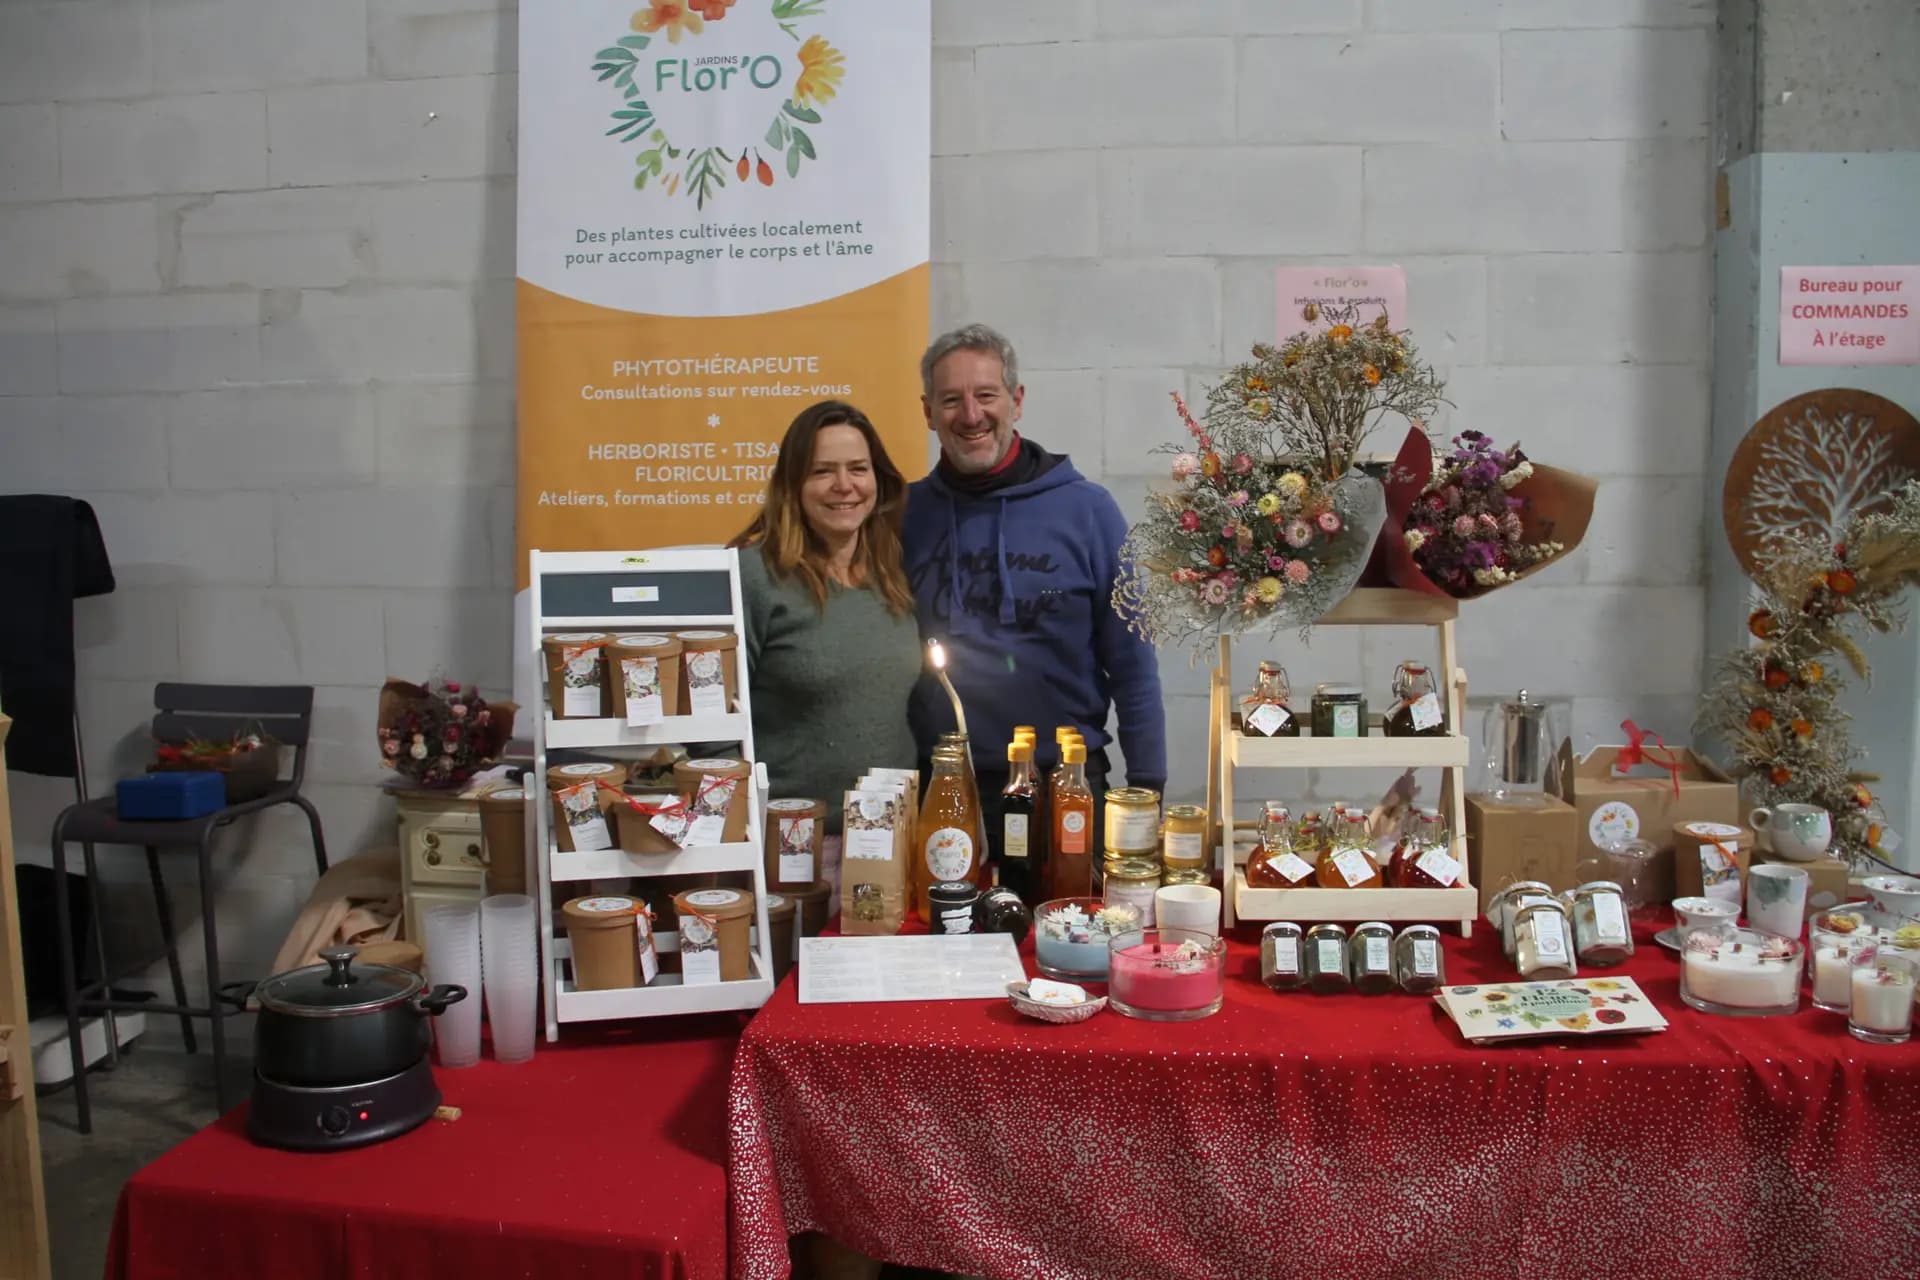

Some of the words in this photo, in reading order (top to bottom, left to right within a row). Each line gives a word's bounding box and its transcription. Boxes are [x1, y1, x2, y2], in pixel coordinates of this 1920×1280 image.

[695, 55, 739, 66] JARDINS
[655, 54, 782, 92] Flor'O
[576, 228, 606, 244] Des
[611, 225, 675, 246] plantes
[679, 223, 757, 240] cultivées
[762, 220, 863, 237] localement
[565, 250, 603, 269] pour
[608, 247, 724, 266] accompagner
[729, 243, 745, 259] le
[749, 244, 798, 262] corps
[802, 241, 821, 257] et
[826, 239, 873, 256] l'âme
[1799, 278, 1858, 293] Bureau
[1863, 280, 1902, 295] pour
[1792, 304, 1909, 319] COMMANDES
[1812, 328, 1825, 347] À
[1829, 331, 1886, 350] l'étage
[613, 353, 819, 377] PHYTOTHÉRAPEUTE
[581, 383, 702, 401] Consultations
[707, 385, 736, 399] sur
[742, 382, 852, 398] rendez-vous
[588, 442, 716, 461] HERBORISTE
[538, 490, 609, 508] Ateliers,
[614, 487, 710, 506] formations
[715, 488, 734, 505] et
